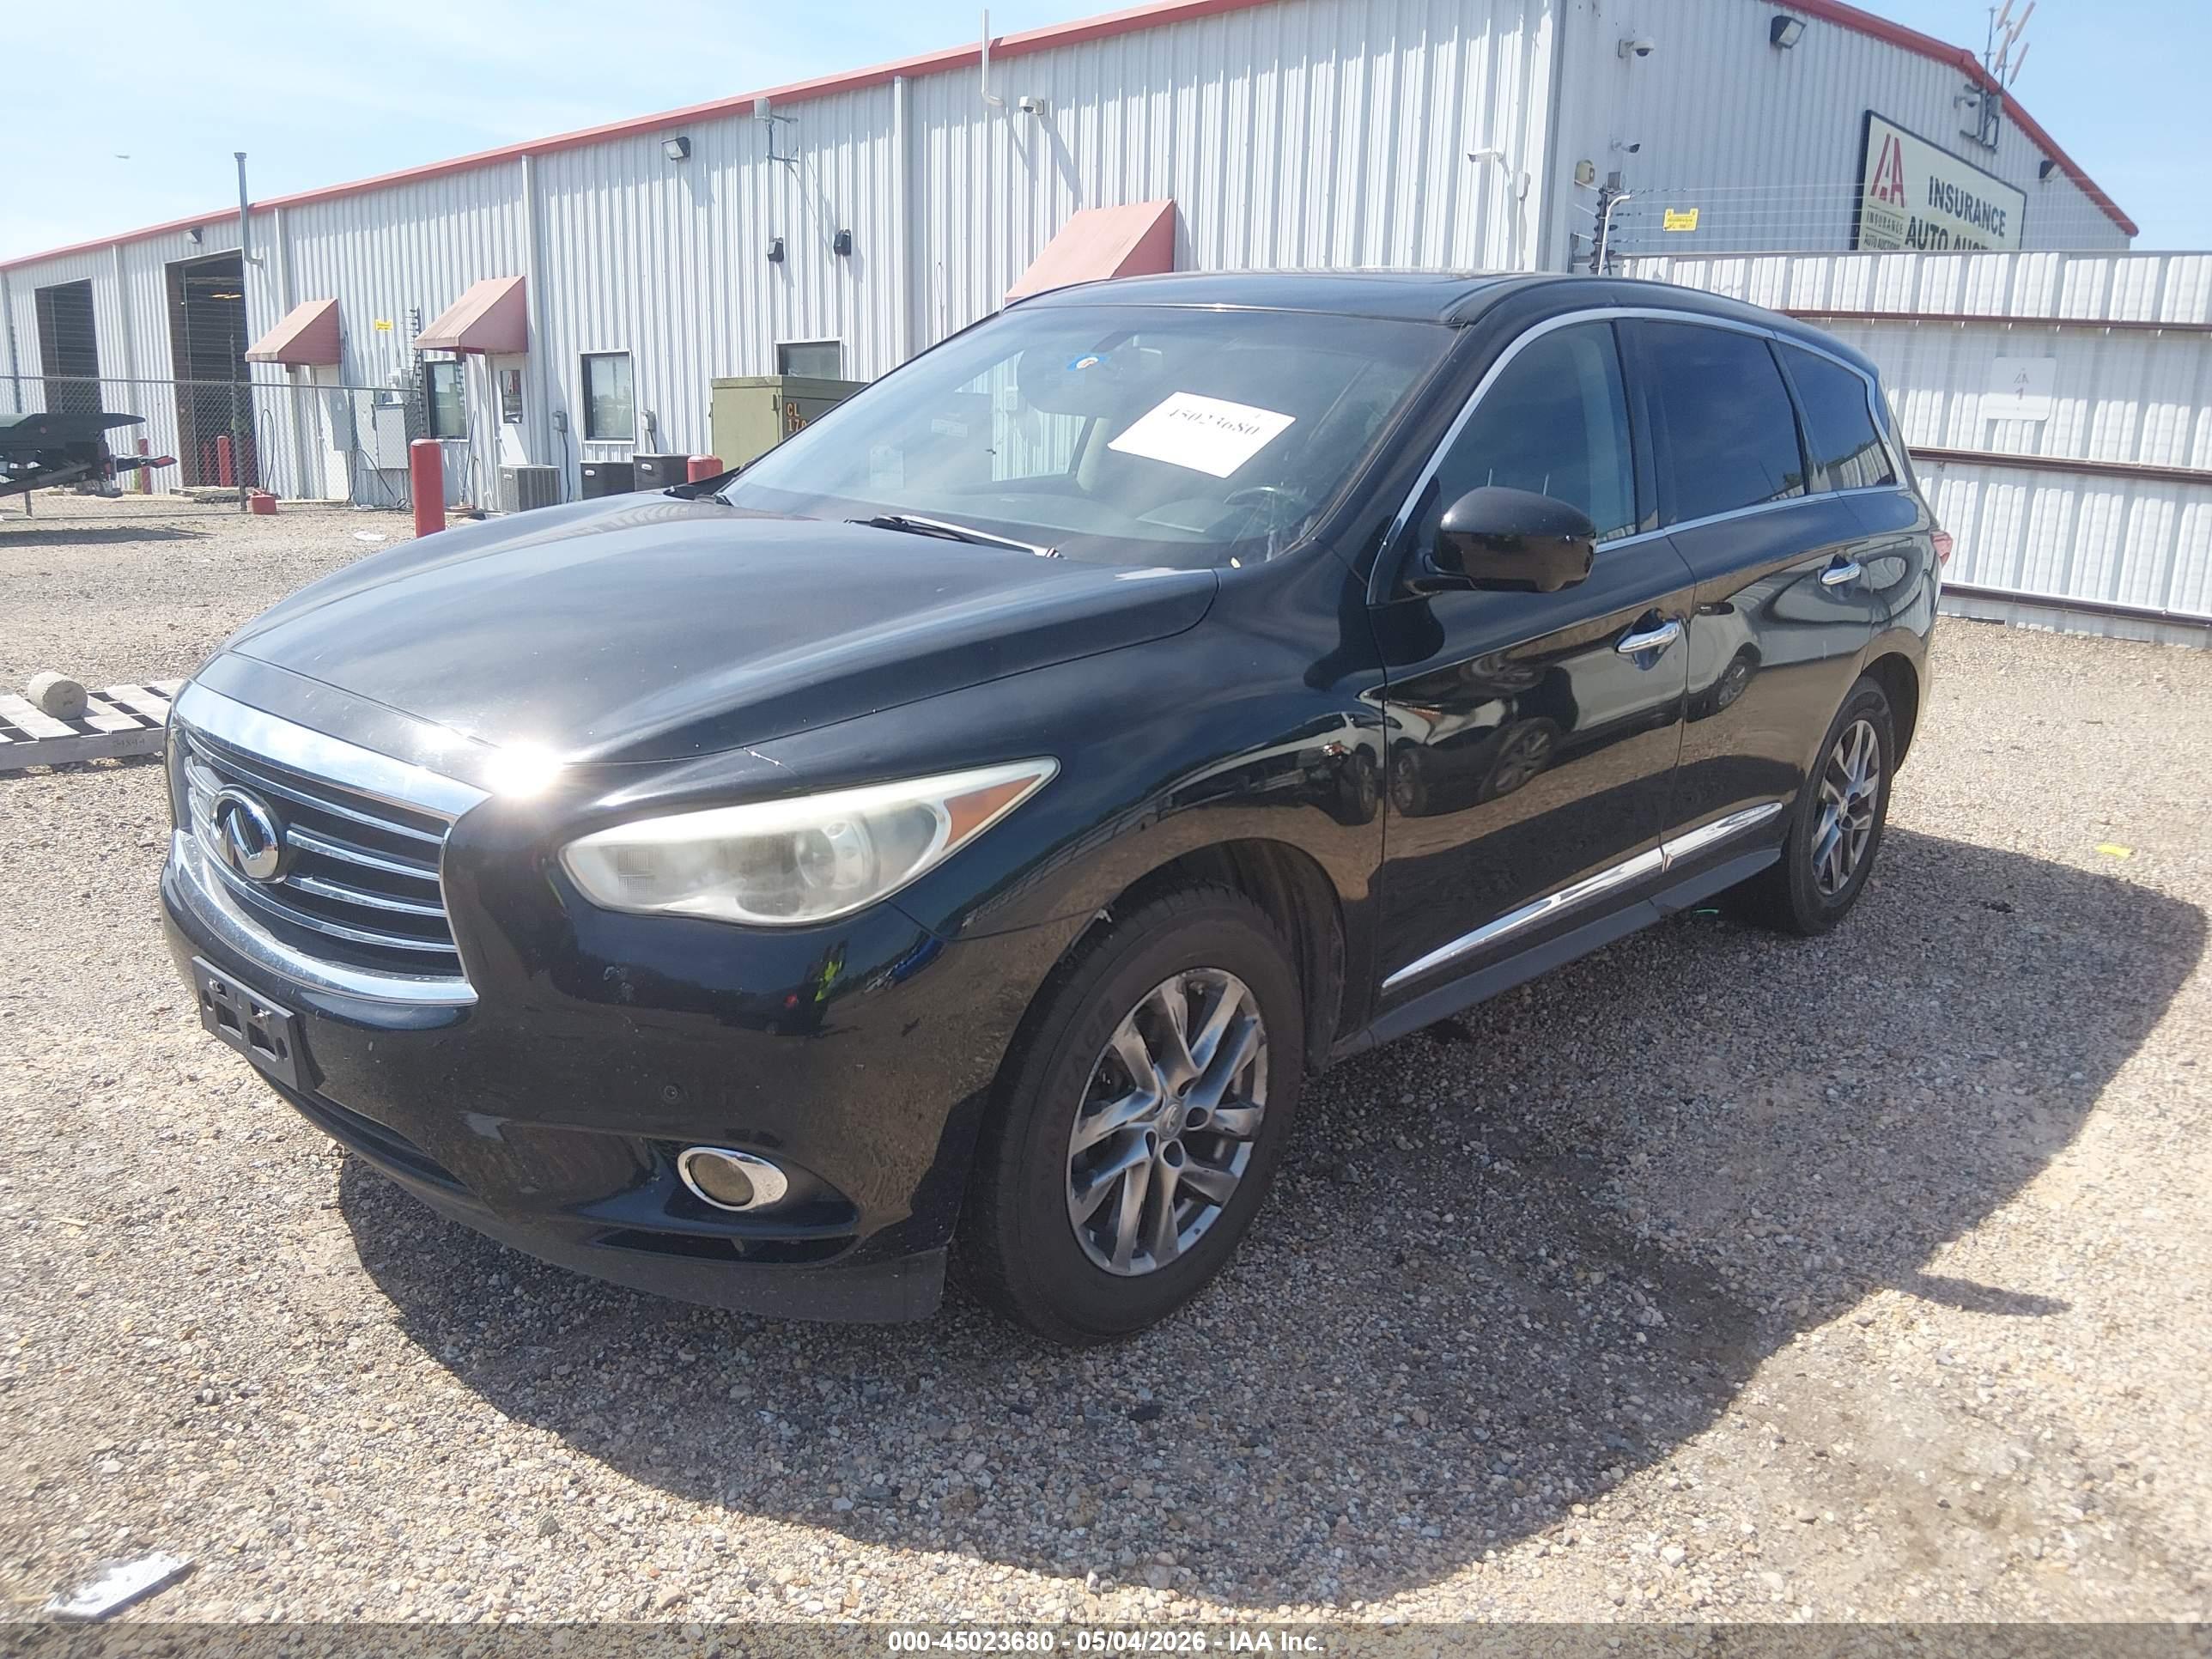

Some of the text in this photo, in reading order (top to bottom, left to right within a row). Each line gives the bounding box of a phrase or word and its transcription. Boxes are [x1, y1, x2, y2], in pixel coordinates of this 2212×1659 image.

[1929, 175, 2007, 239] INSURANCE
[1905, 216, 1948, 250] AUTO
[787, 402, 800, 416] CL
